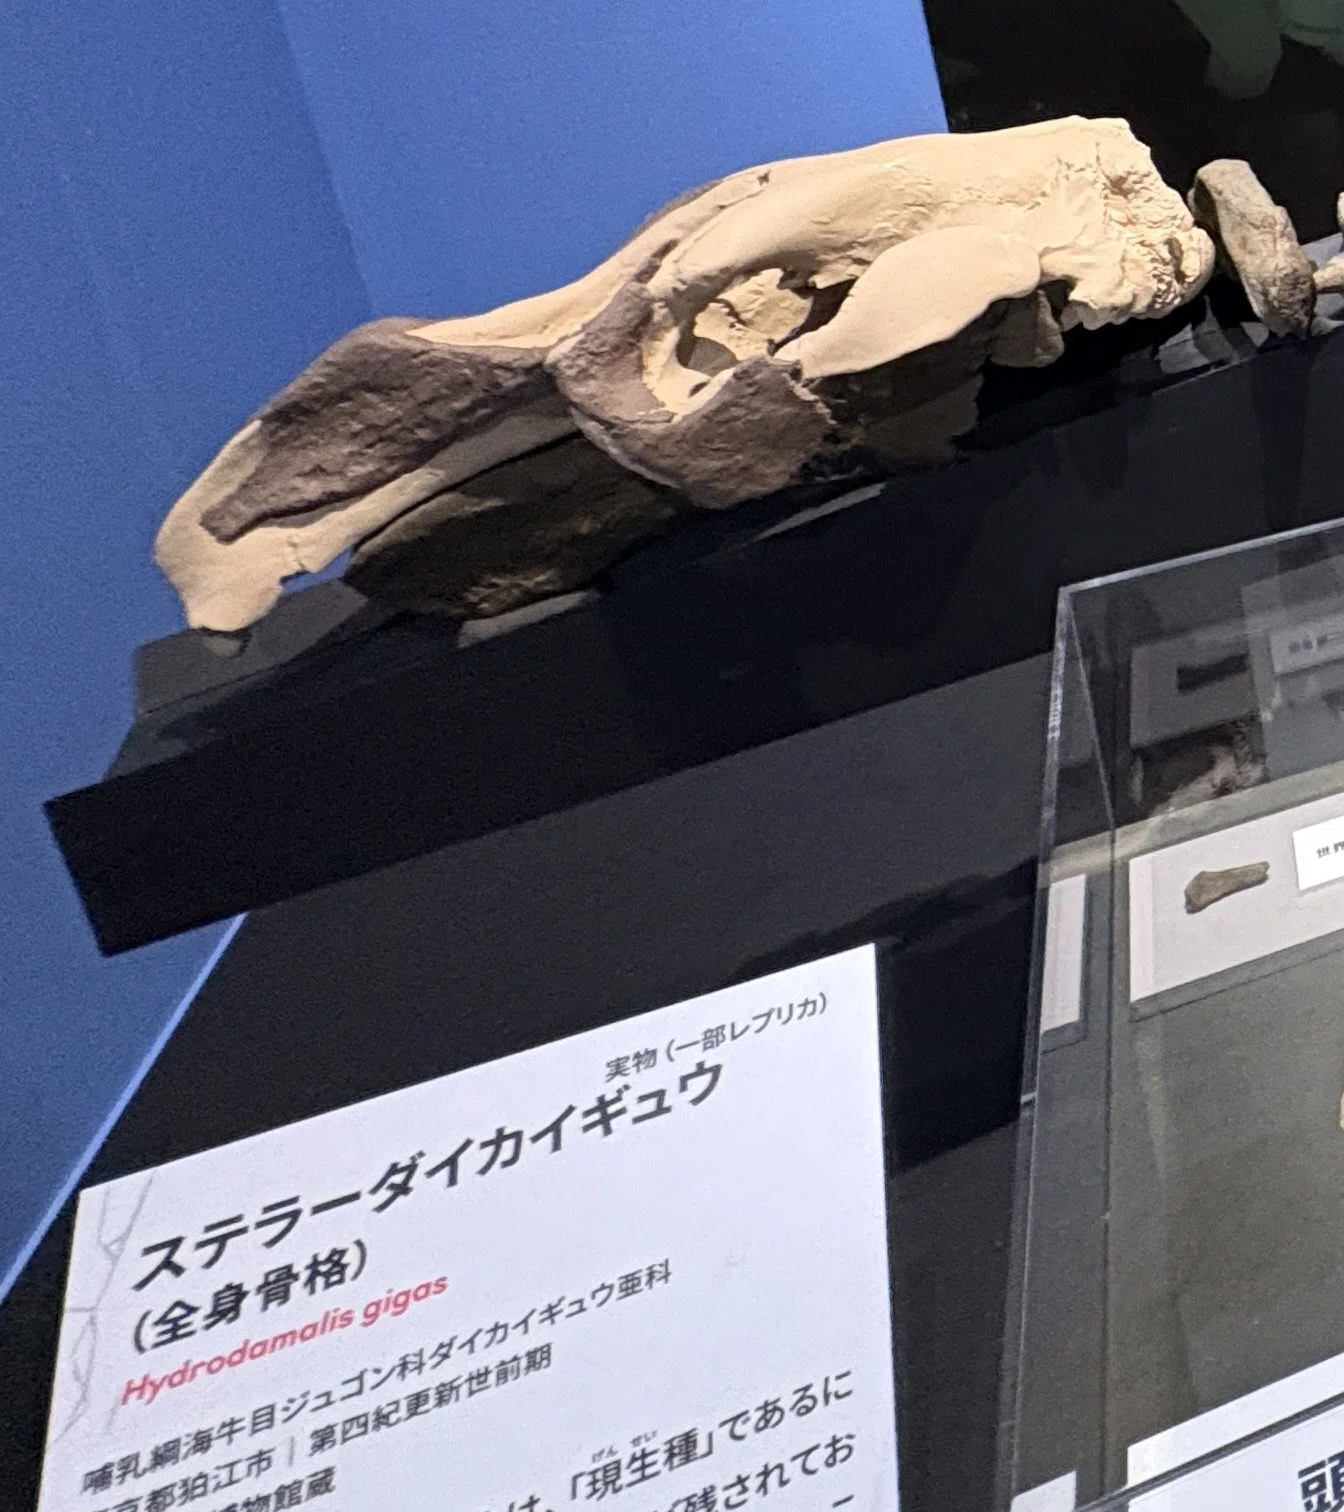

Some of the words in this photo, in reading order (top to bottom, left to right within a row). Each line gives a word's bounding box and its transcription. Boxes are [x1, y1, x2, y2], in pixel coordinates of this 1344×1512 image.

[604, 991, 828, 1083] 実物（一部レプリカ）
[131, 1059, 724, 1292] ステラーダイカイギュウ
[120, 1306, 355, 1405] Hydrodamalis
[360, 1275, 449, 1327] gigas
[134, 1238, 367, 1354] （全身骨格）
[210, 1465, 337, 1512] 物館蔵
